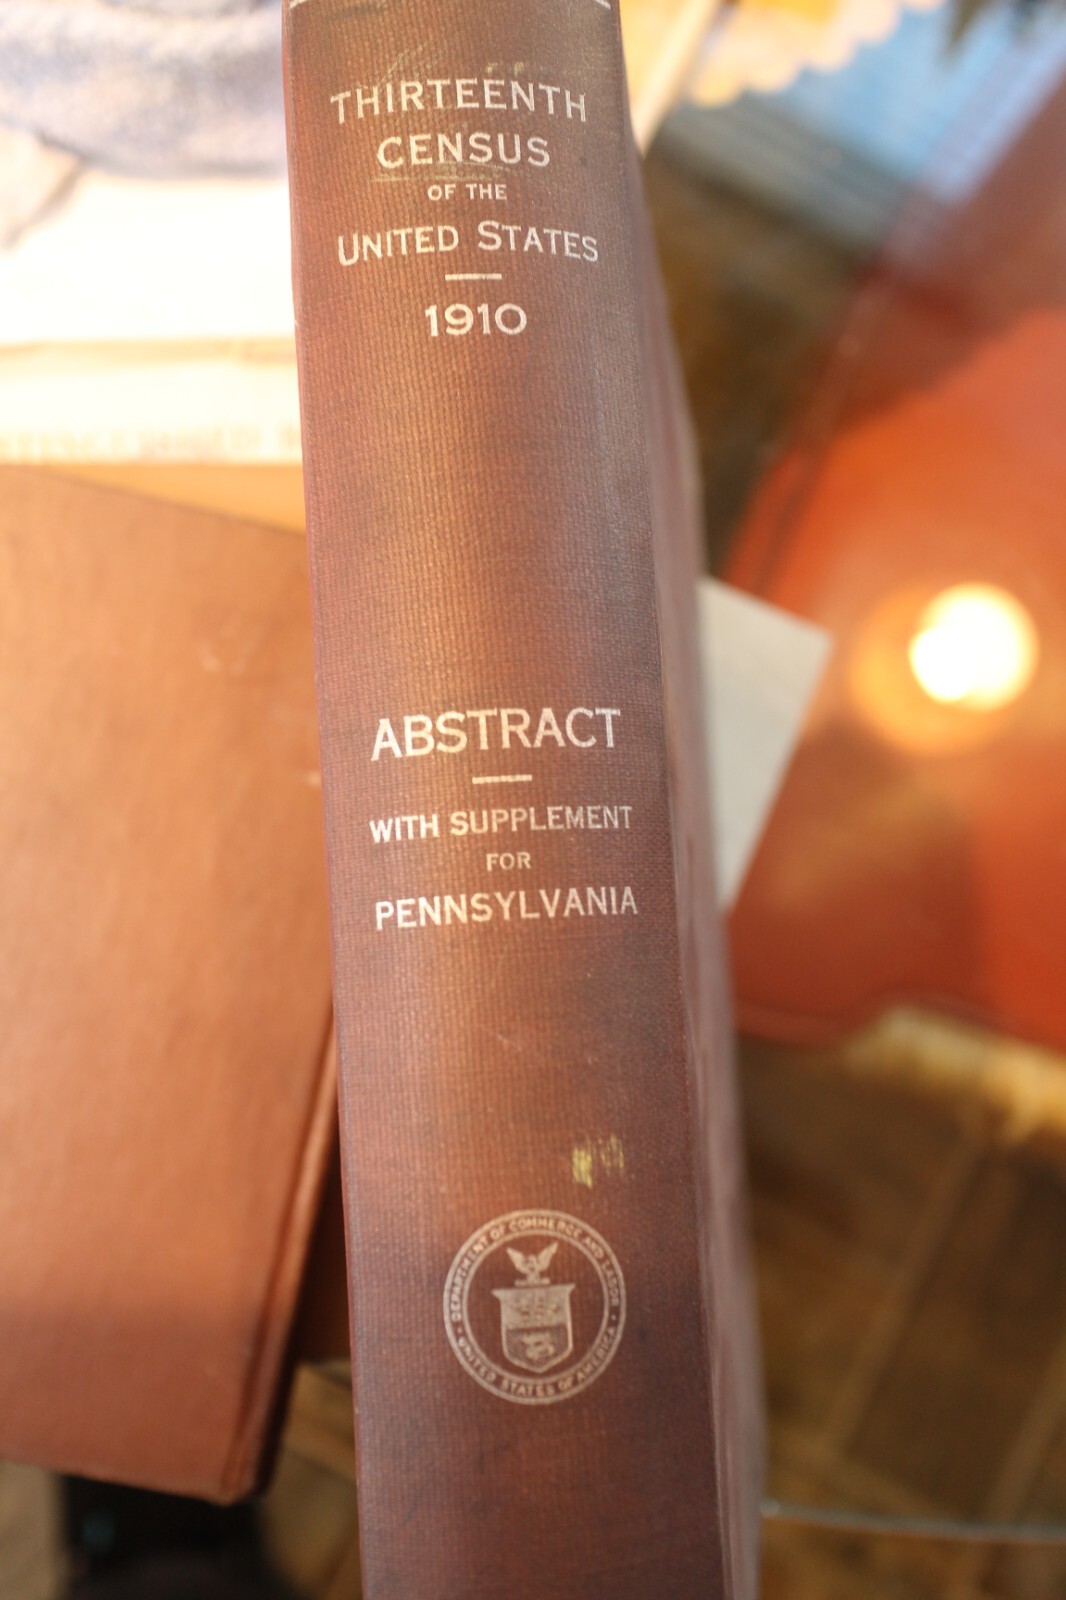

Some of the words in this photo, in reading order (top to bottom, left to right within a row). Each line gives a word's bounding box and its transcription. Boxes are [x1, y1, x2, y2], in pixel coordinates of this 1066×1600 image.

[331, 78, 586, 124] THIRTEENTH
[377, 132, 551, 169] CENSUS
[427, 184, 456, 201] OF
[466, 183, 507, 200] THE
[338, 225, 459, 266] UNITED
[478, 220, 599, 262] STATES
[425, 303, 527, 337] 1910
[370, 706, 620, 761] ABSTRACT
[370, 814, 439, 844] WITH
[450, 806, 632, 836] SUPPLEMENT
[486, 852, 532, 871] FOR
[376, 886, 638, 930] PENNSYLVANIA
